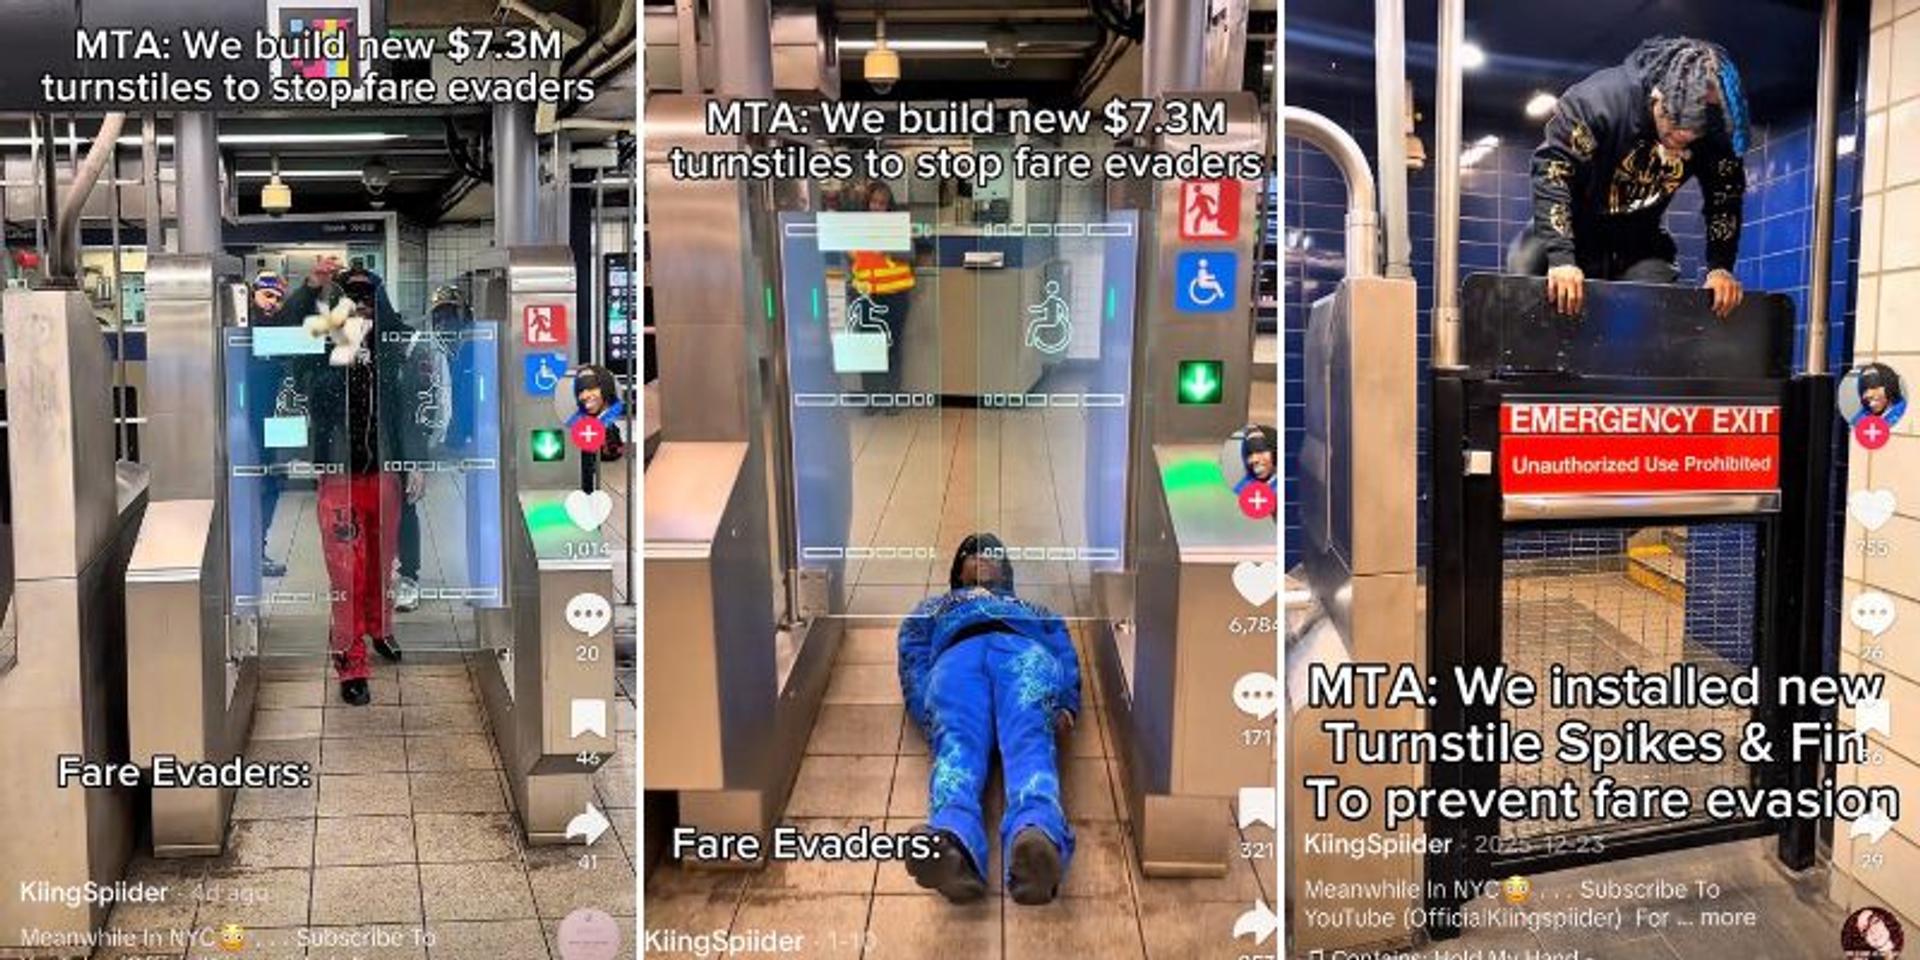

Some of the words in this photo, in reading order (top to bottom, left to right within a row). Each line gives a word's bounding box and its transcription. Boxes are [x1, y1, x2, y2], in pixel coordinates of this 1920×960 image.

[1510, 405, 1698, 433] EMERGENCY
[1712, 408, 1773, 433] EXIT
[1512, 456, 1639, 474] Unauthorized
[1645, 456, 1679, 473] Use
[1684, 454, 1771, 472] Prohibited
